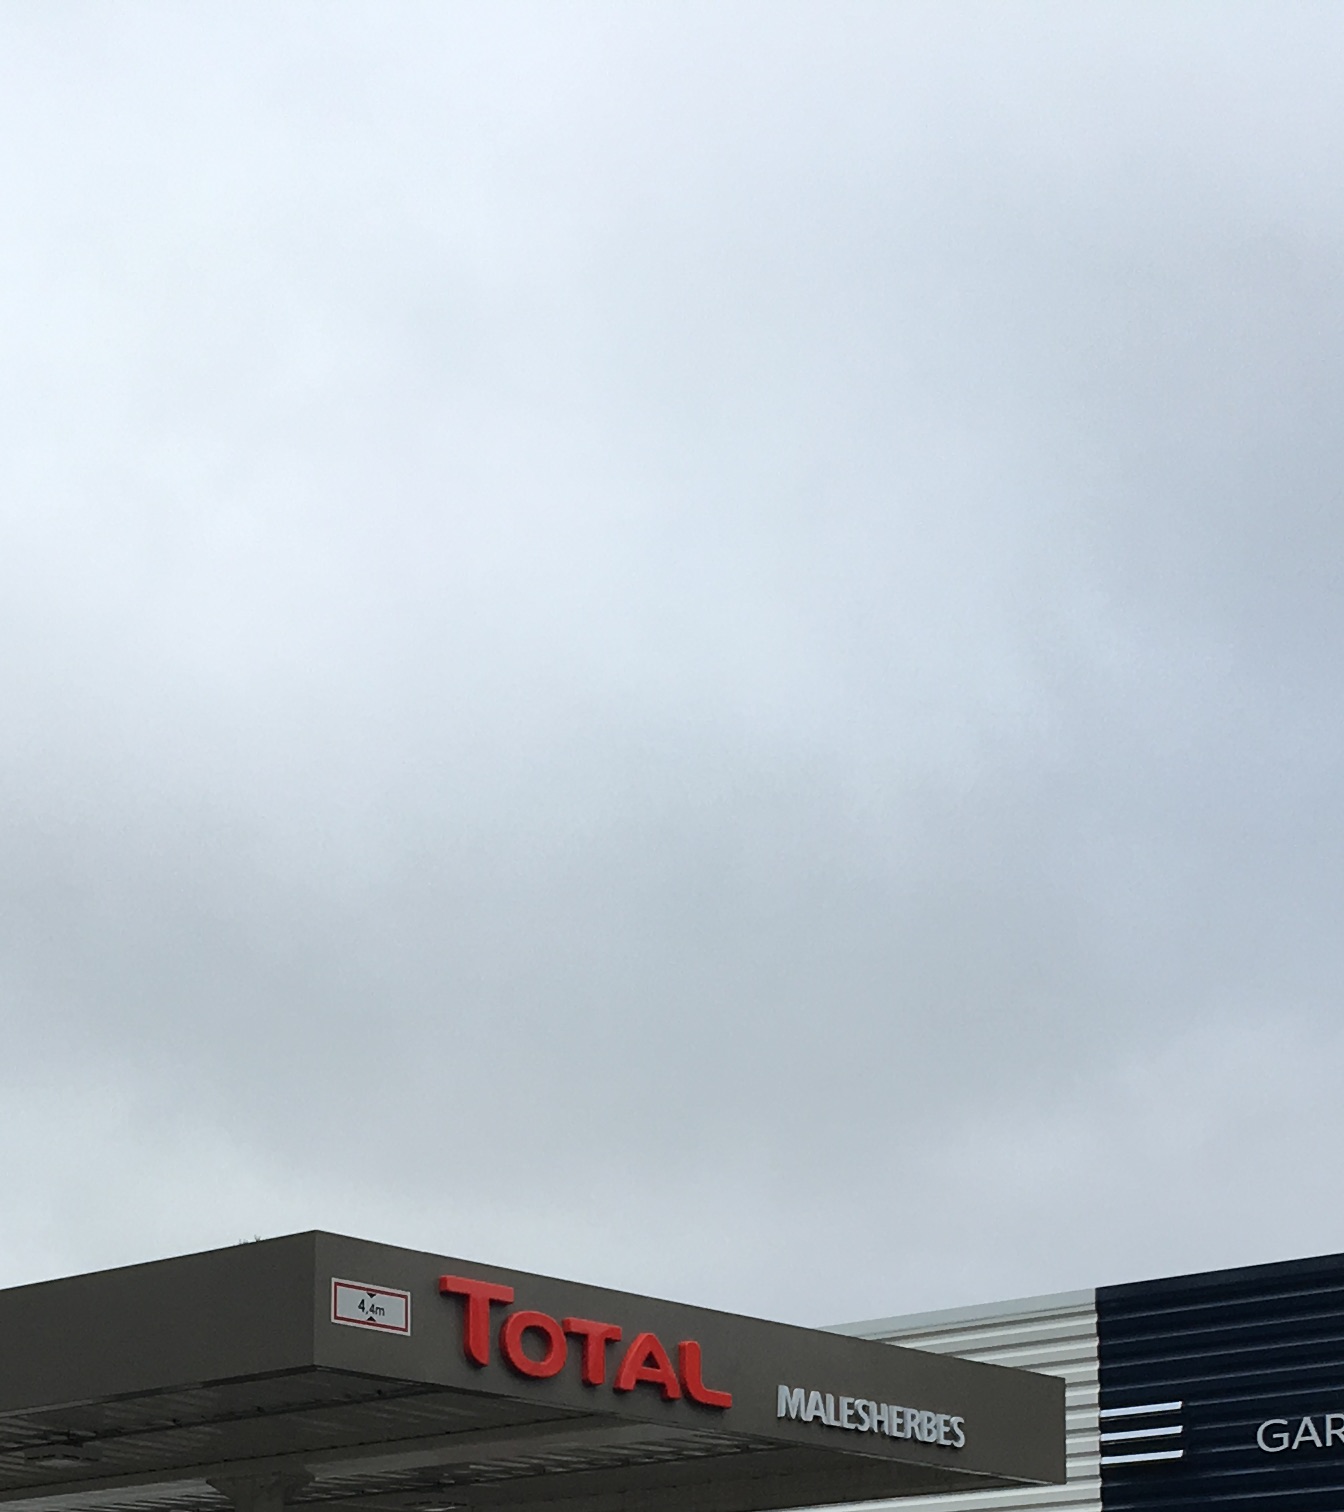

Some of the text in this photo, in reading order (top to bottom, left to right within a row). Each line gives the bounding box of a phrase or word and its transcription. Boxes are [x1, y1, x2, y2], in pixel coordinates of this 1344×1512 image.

[357, 1298, 385, 1317] 4,4m
[439, 1275, 732, 1409] TOTAL
[776, 1384, 966, 1448] MALESHERBES
